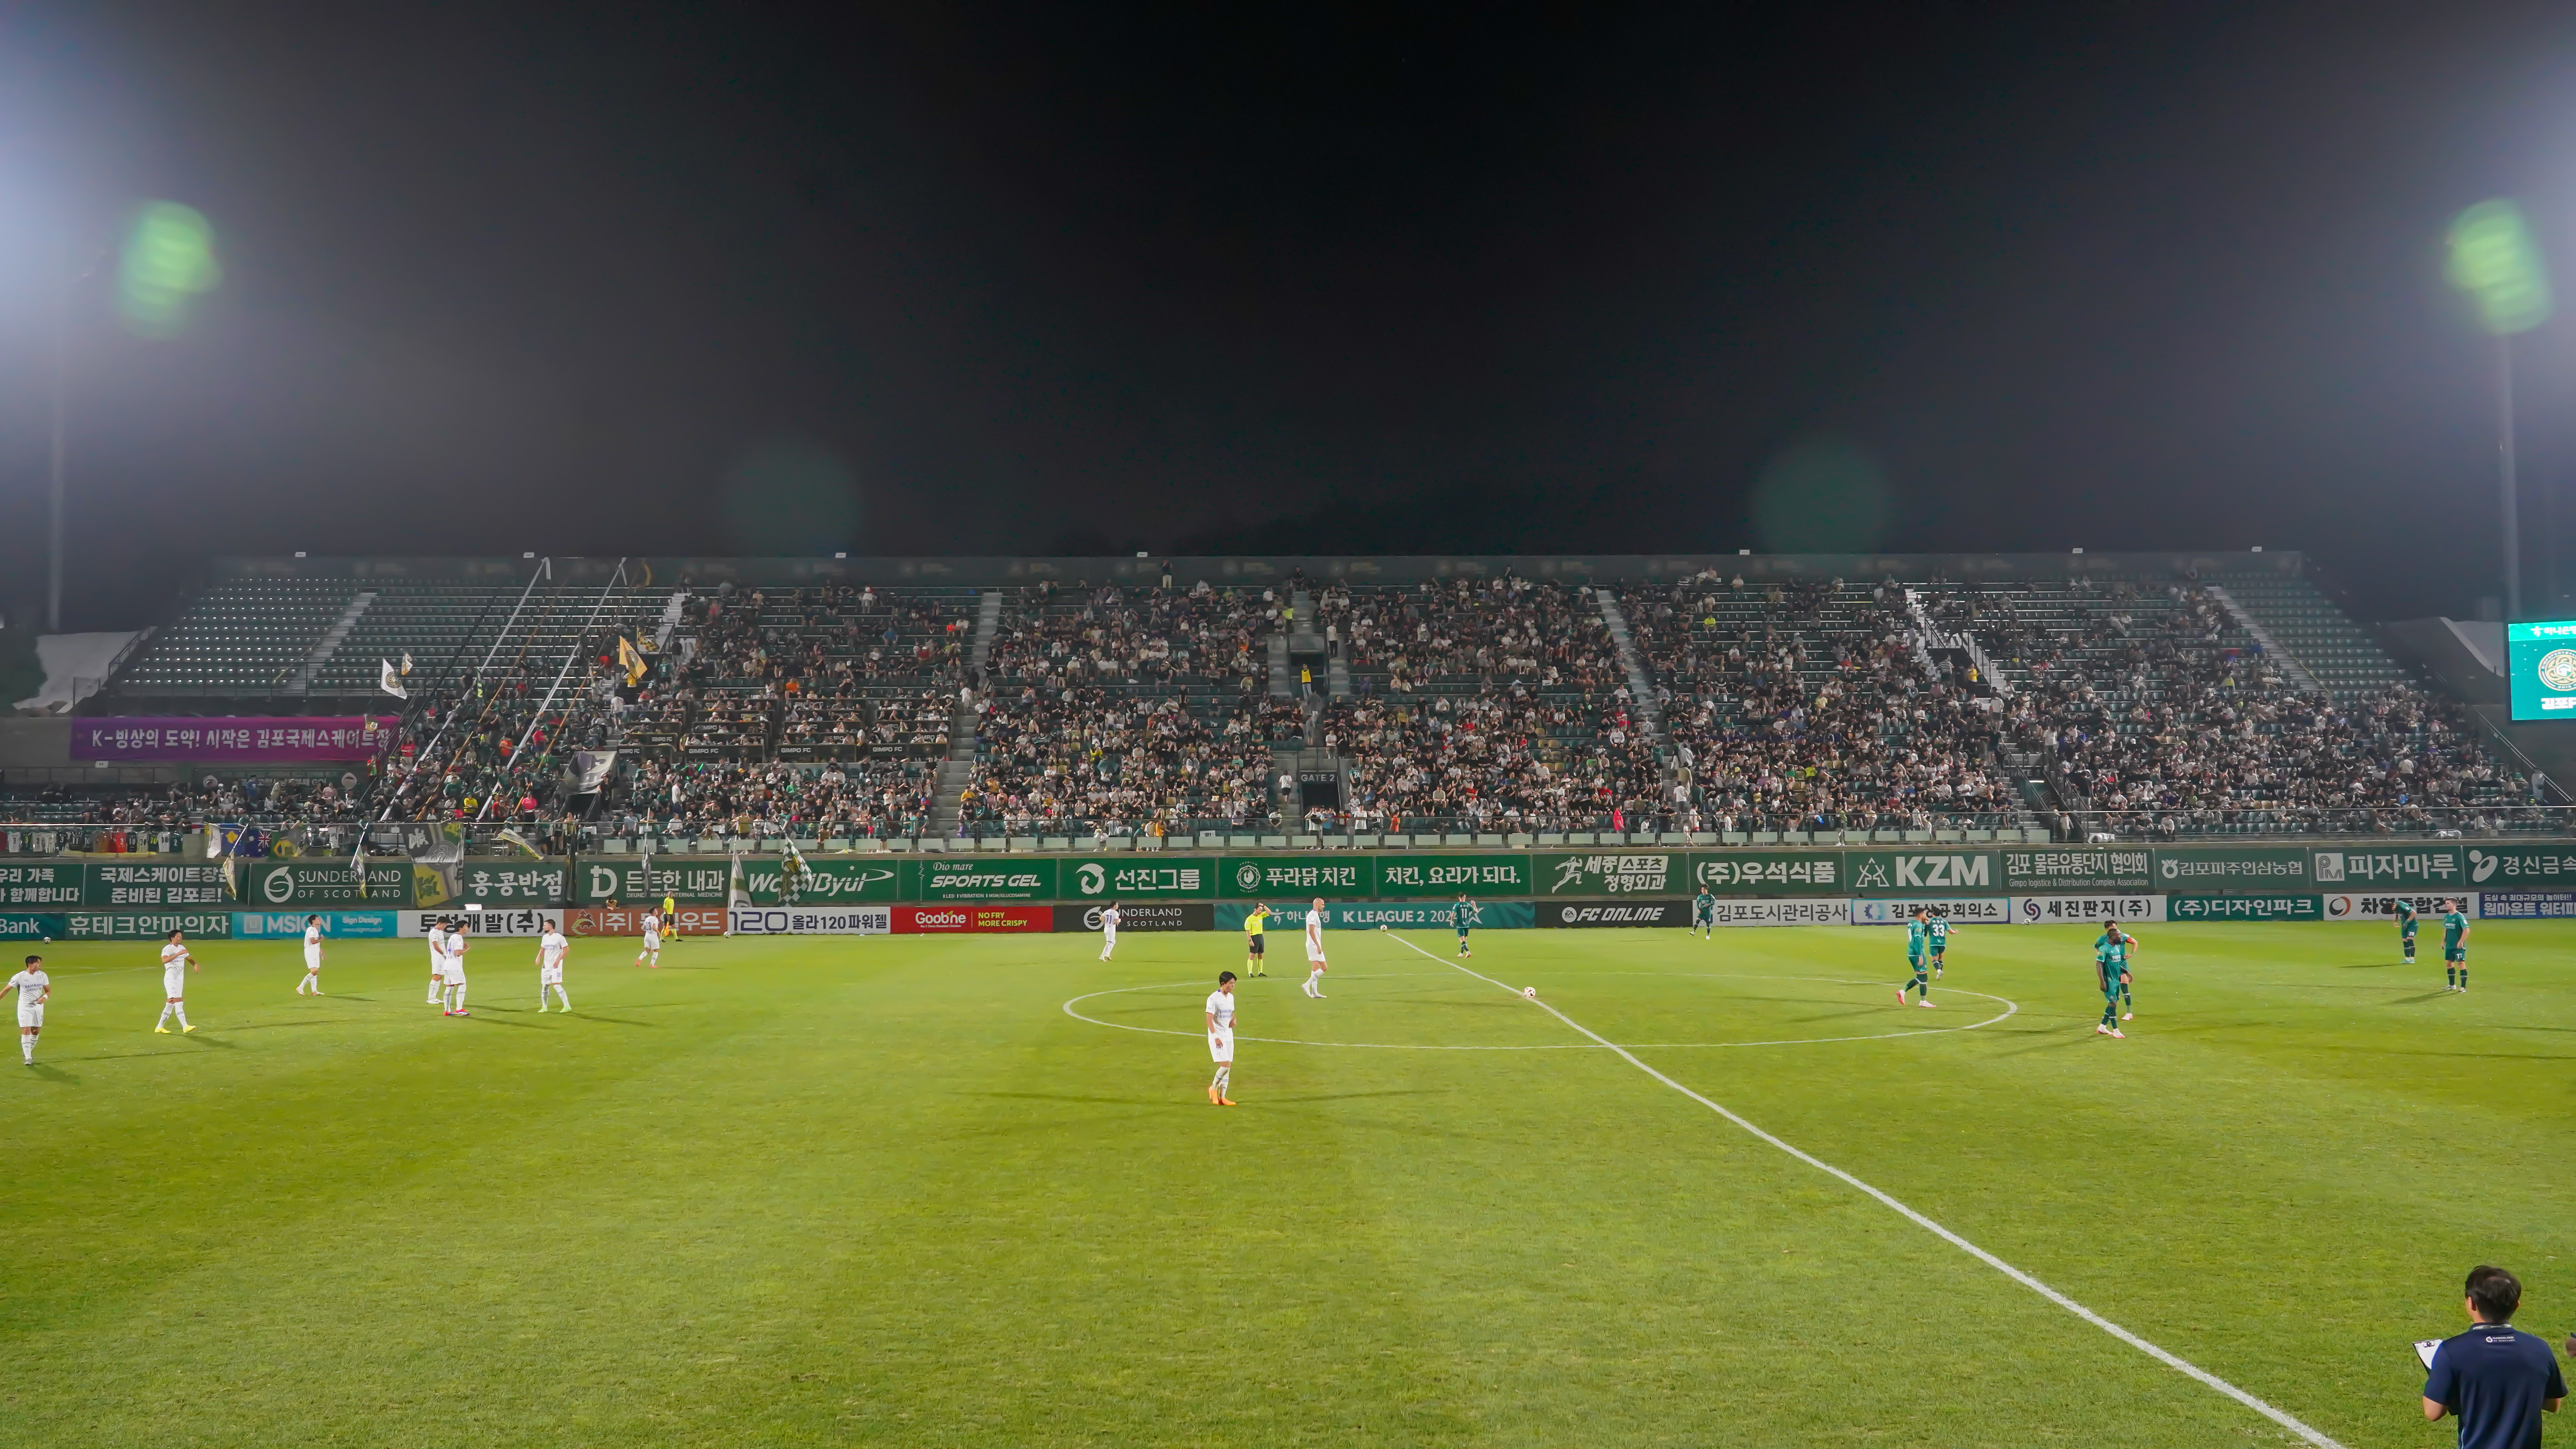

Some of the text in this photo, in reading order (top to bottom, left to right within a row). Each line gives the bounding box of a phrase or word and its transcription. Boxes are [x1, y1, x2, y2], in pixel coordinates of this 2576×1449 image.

[92, 728, 159, 749] K-빙상의
[165, 729, 200, 748] 도약!
[206, 729, 250, 749] 시작은
[933, 862, 949, 871] Dio
[1896, 856, 1989, 886] KZM
[2007, 852, 2148, 875] 김포 물류유통단지 협의회
[2179, 861, 2302, 875] 김포파주인삼농협
[2349, 854, 2458, 880] 피자마루
[2503, 856, 2576, 875] 경신금속
[0, 868, 54, 883] 우리 가족
[298, 870, 401, 883] SUNDERAND
[688, 870, 724, 891] 내과
[1115, 869, 1200, 890] 선진그룹
[1266, 867, 1355, 886] 푸라닭 치킨
[1386, 866, 1521, 886] 치킨, 요리가 되다.
[1696, 861, 1835, 884] (주)우석식품
[469, 870, 564, 897] 홍콩반점
[749, 873, 867, 897] WoiByul
[930, 874, 1041, 888] SPORTS GEL
[1604, 875, 1666, 892] 정형외과
[2009, 879, 2027, 888] Gimpo
[2059, 878, 2090, 887] Distribution
[2092, 878, 2115, 887] Complex
[2117, 878, 2148, 886] Association
[11, 888, 79, 902] 함께합니다
[111, 887, 222, 903] 준비된 김포로!
[298, 889, 400, 898] OF SCOTAND
[1118, 908, 1182, 917] UNDERLAND
[1461, 908, 1467, 918] 11
[1577, 908, 1665, 921] FC ONLINE
[1717, 904, 1847, 922] 김포도시관리공사
[2047, 900, 2151, 917] 세진판지(주)
[2175, 900, 2314, 916] (주)디자인파크
[2484, 903, 2536, 915] 원마운트
[343, 916, 381, 925] Sign Design
[1287, 911, 1330, 923] 하나행
[1343, 911, 1355, 922] K
[1358, 911, 1413, 922] LEAGUE
[1417, 911, 1425, 922] 2
[0, 918, 40, 934] Bank
[69, 916, 228, 935] 휴테크안마의자
[1932, 925, 1944, 936] 33
